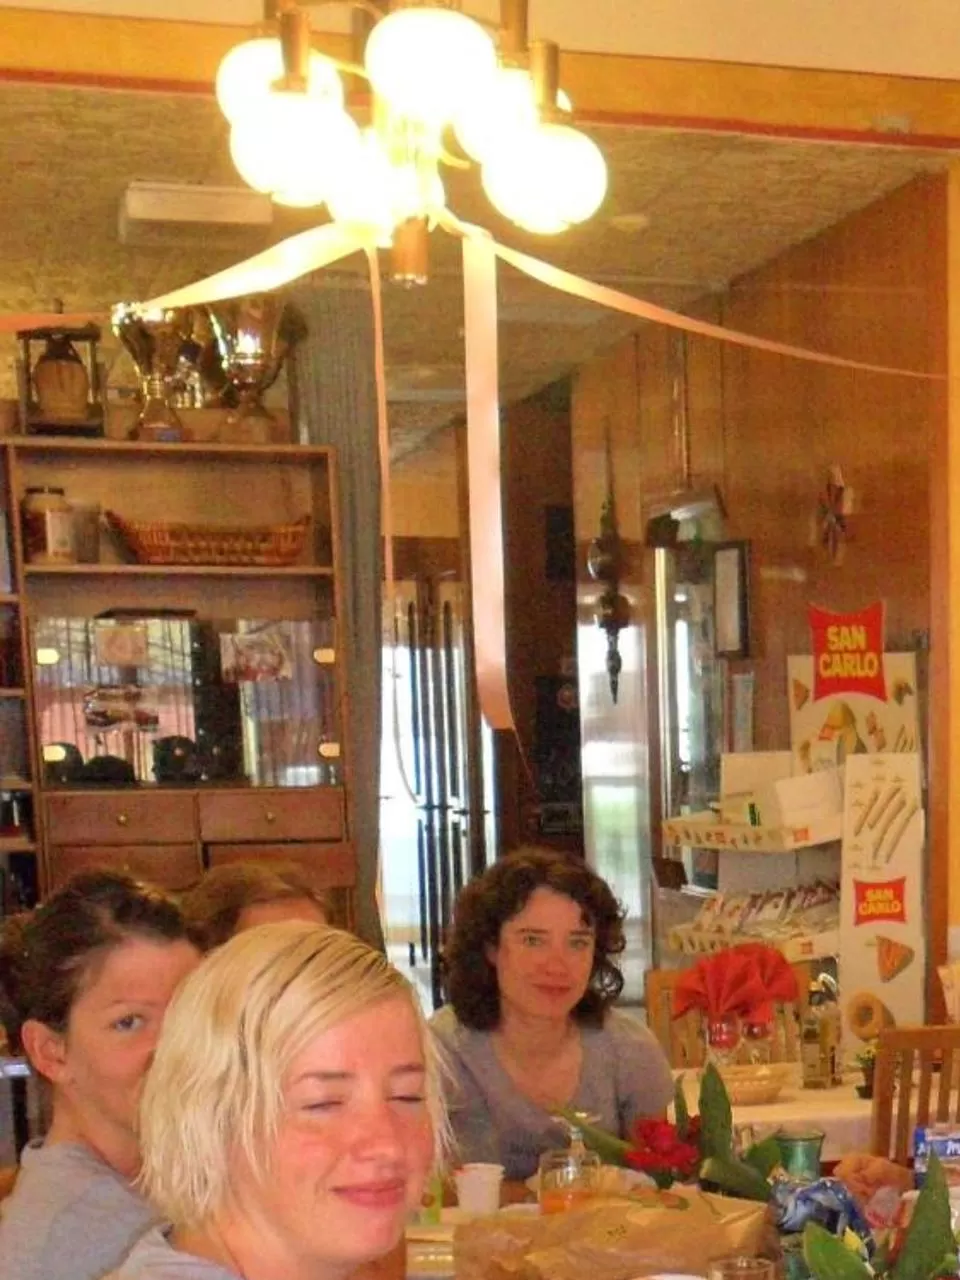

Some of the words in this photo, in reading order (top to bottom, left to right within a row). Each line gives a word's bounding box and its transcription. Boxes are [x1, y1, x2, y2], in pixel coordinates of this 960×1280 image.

[827, 625, 867, 651] SAN
[819, 651, 878, 679] CARLO
[865, 887, 894, 901] SAN
[859, 900, 902, 916] CARLO
